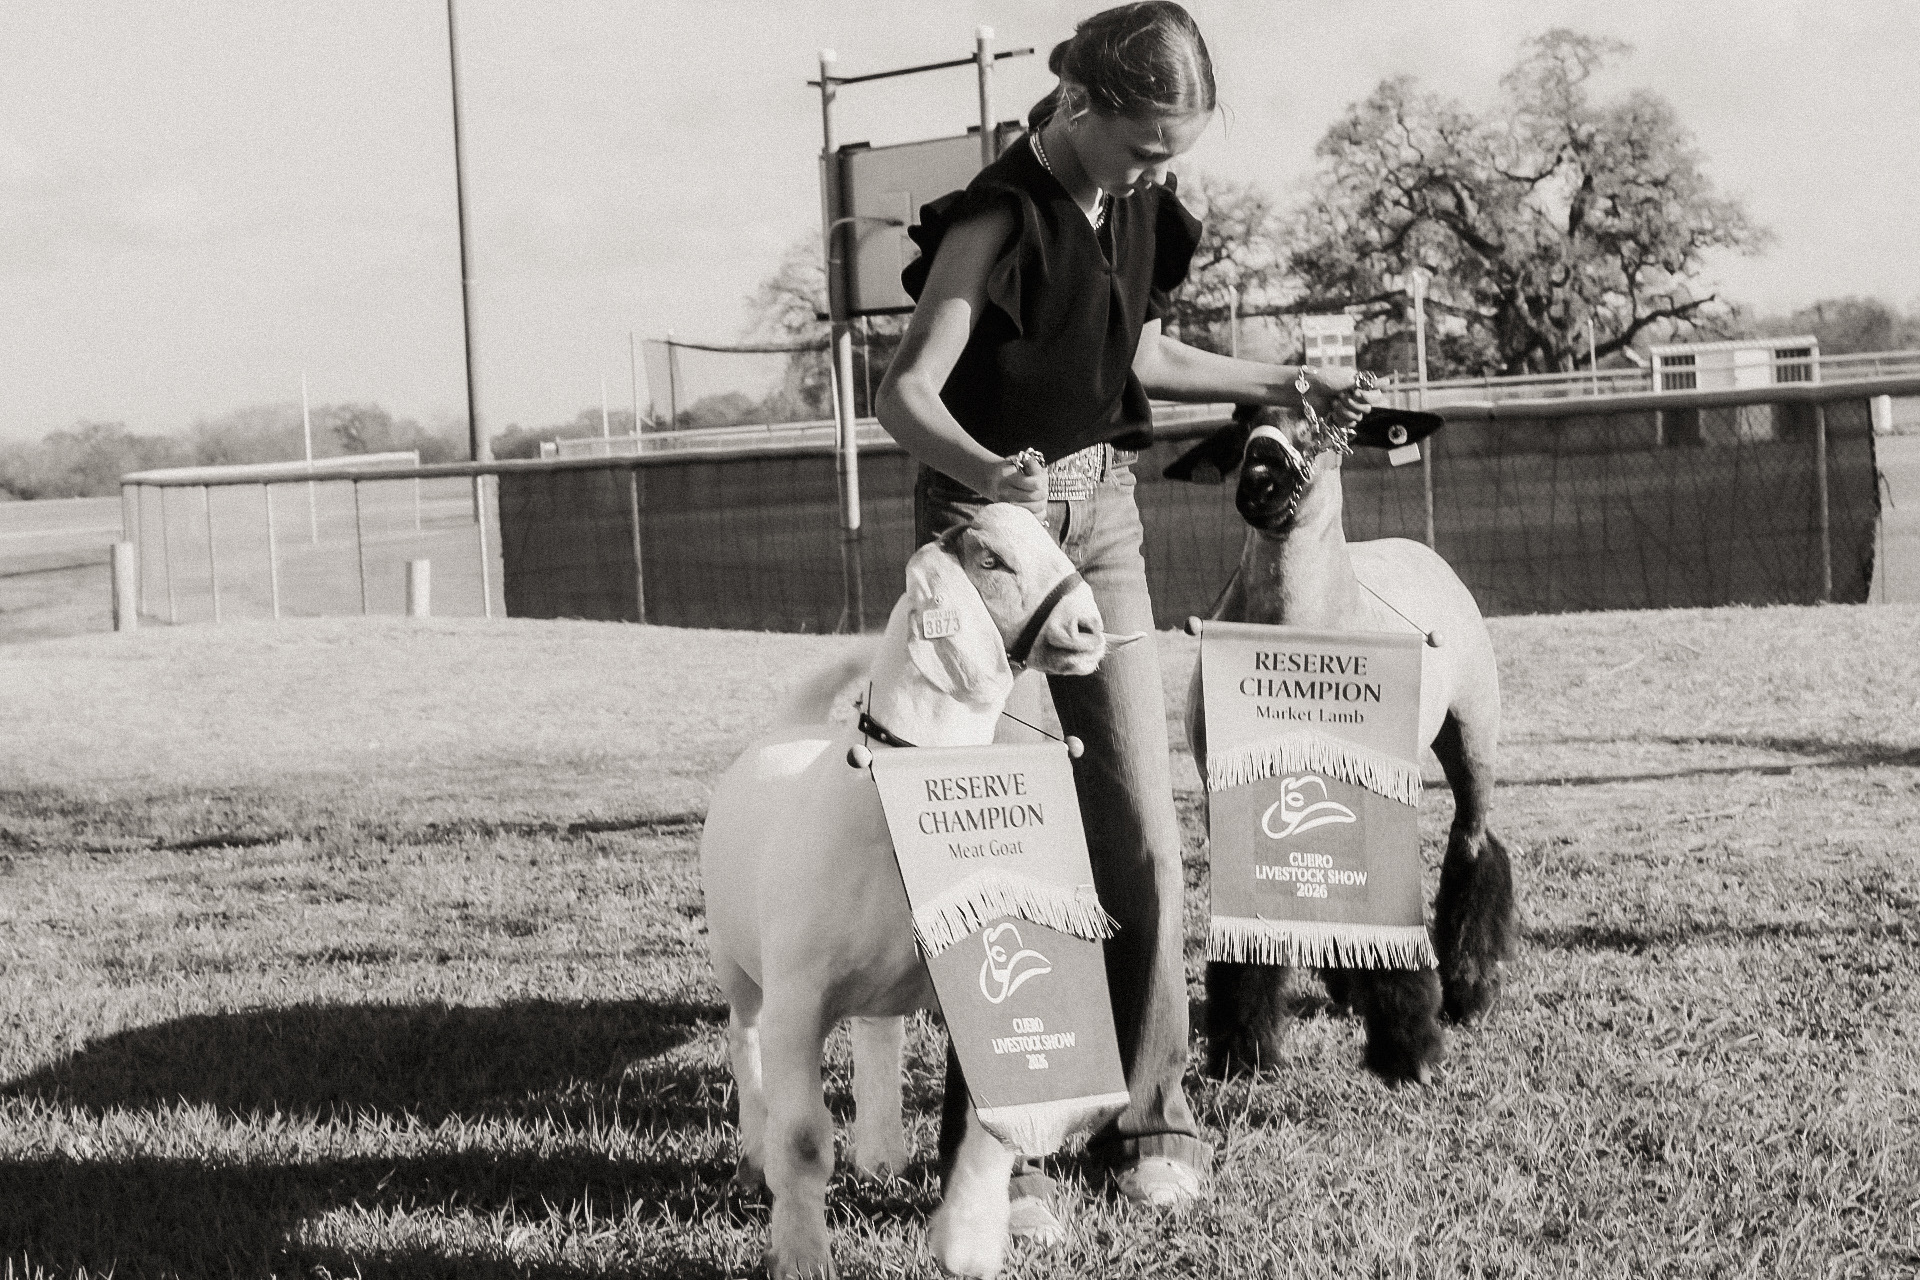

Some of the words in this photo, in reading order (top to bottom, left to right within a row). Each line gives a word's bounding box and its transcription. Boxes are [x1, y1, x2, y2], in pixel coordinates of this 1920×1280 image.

[926, 617, 961, 635] 3873
[1255, 651, 1367, 675] RESERVE
[1239, 677, 1381, 702] CHAMPION
[1256, 705, 1312, 721] Market
[1319, 708, 1364, 723] Lamb
[924, 773, 1027, 802] RESERVE
[918, 803, 1044, 835] CHAMPION
[947, 842, 985, 860] Meat
[989, 839, 1024, 857] Goat
[1289, 852, 1333, 868] CUERO
[1255, 865, 1325, 883] LIVESTOCK
[1327, 869, 1368, 886] SHOW
[1296, 882, 1328, 899] 2026
